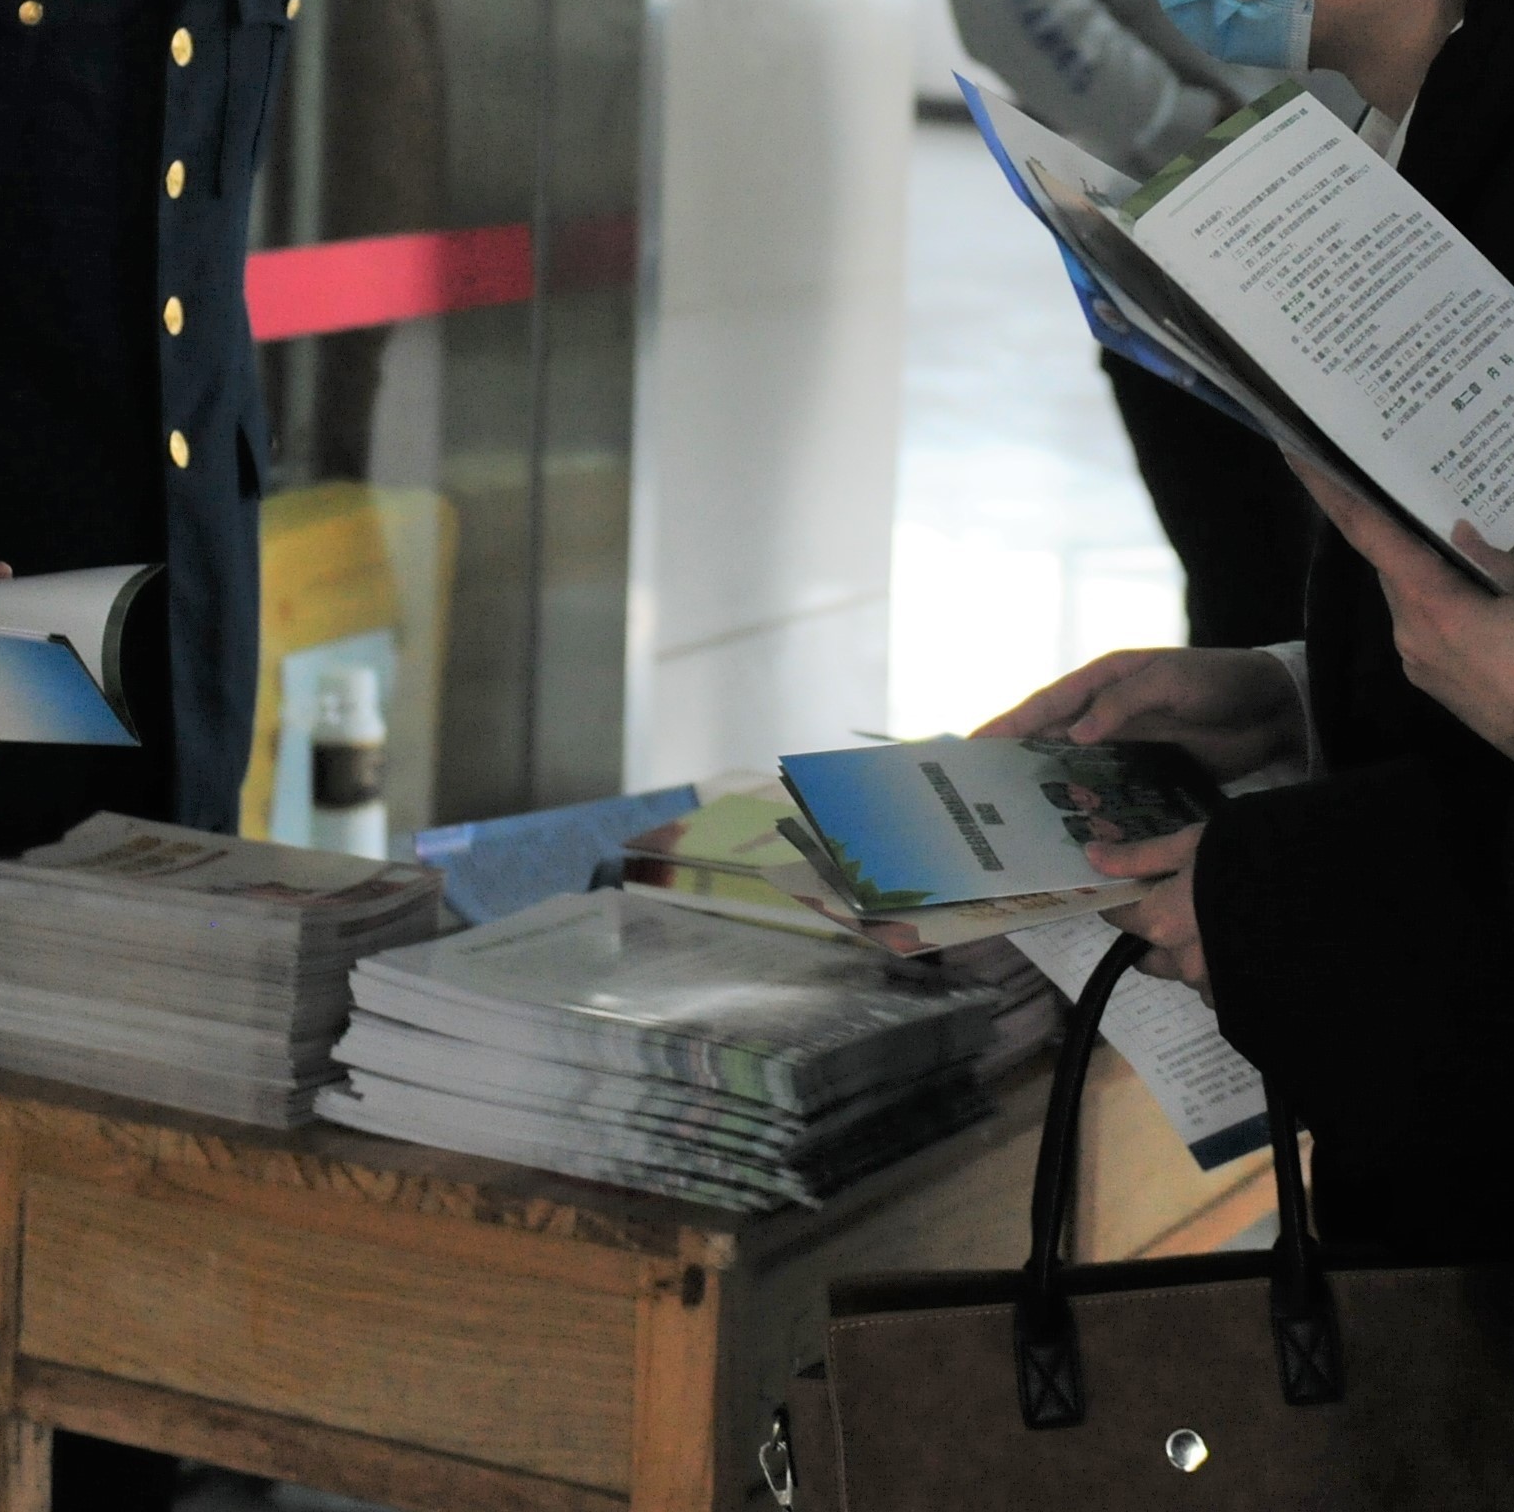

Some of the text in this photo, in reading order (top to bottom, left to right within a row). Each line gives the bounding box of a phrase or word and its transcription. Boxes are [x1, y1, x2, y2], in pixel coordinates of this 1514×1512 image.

[1448, 352, 1514, 413] 第二章 内 科
